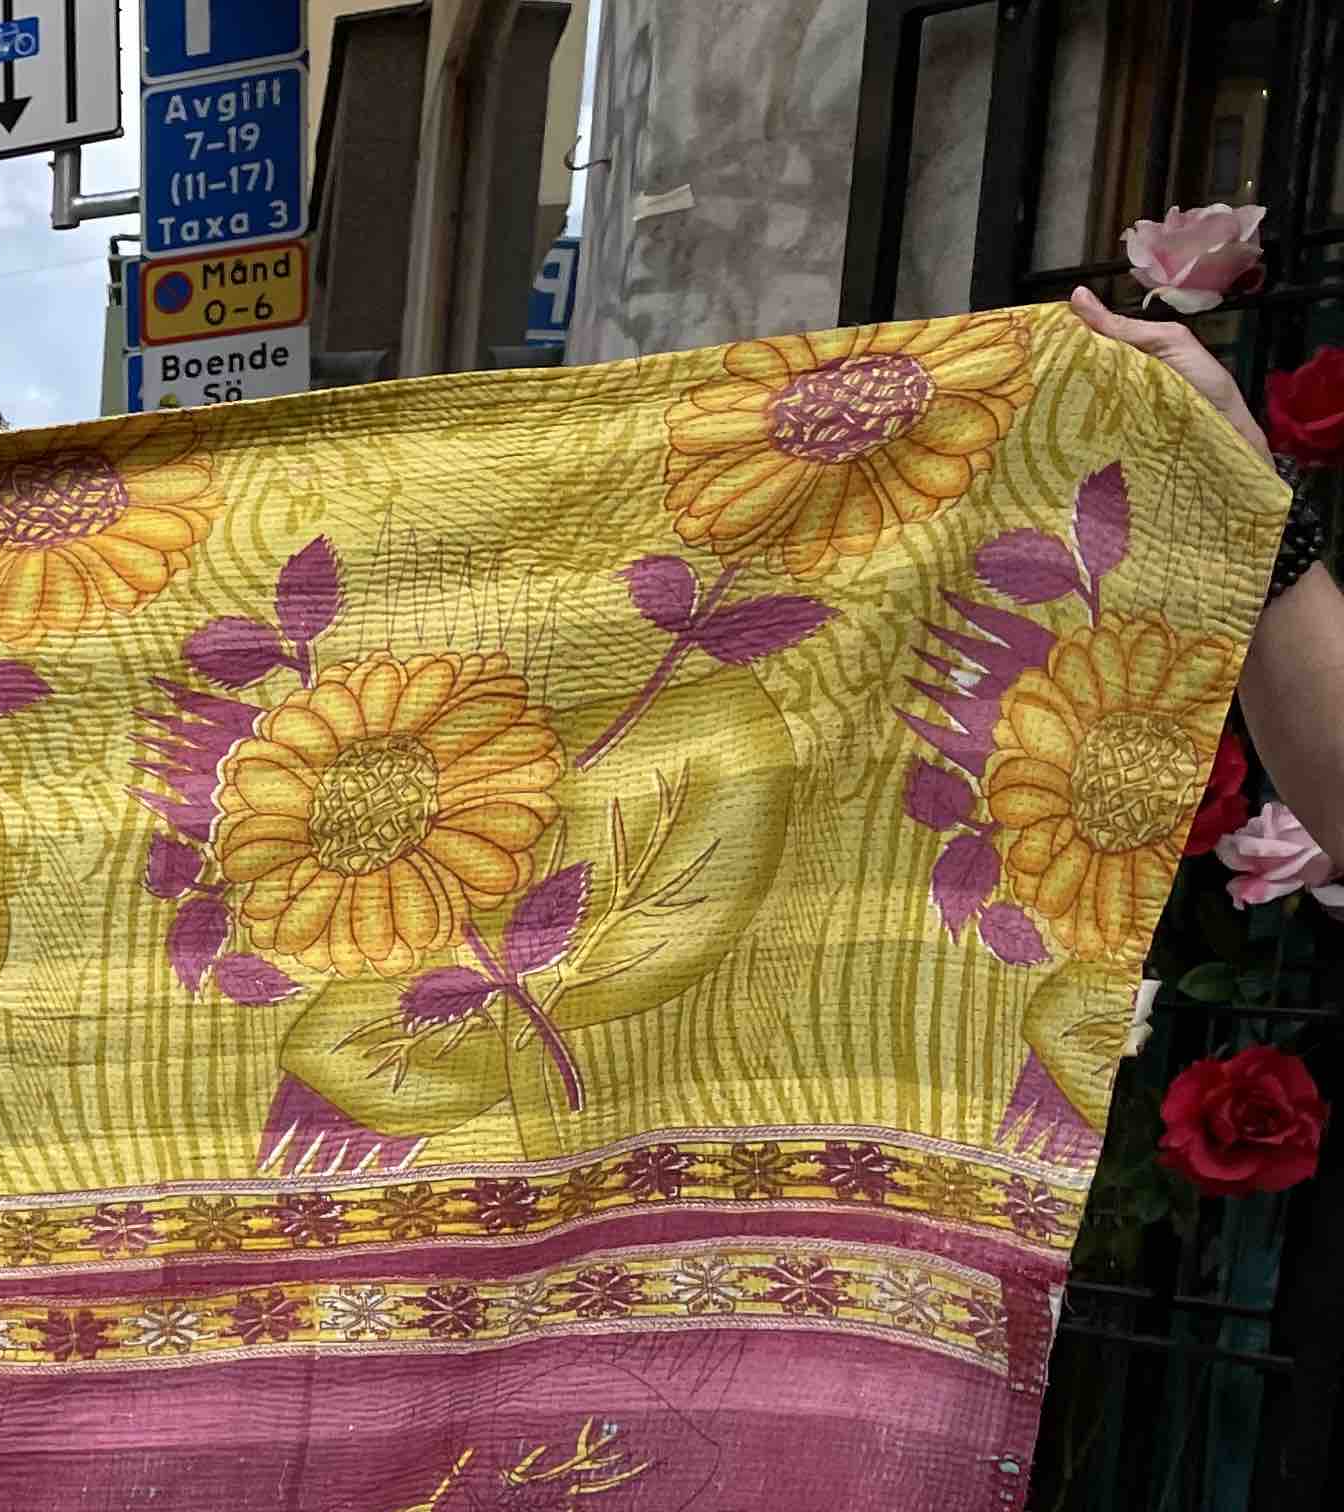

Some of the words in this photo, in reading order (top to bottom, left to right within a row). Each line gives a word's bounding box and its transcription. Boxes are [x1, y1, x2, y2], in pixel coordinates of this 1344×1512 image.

[164, 78, 281, 124] Avgift
[184, 123, 261, 161] 7-19
[170, 158, 275, 207] (11-17)
[158, 212, 249, 246] Taxa
[268, 200, 289, 230] 3
[201, 252, 291, 291] Månd
[203, 294, 274, 326] 0-6
[161, 342, 290, 382] Boende
